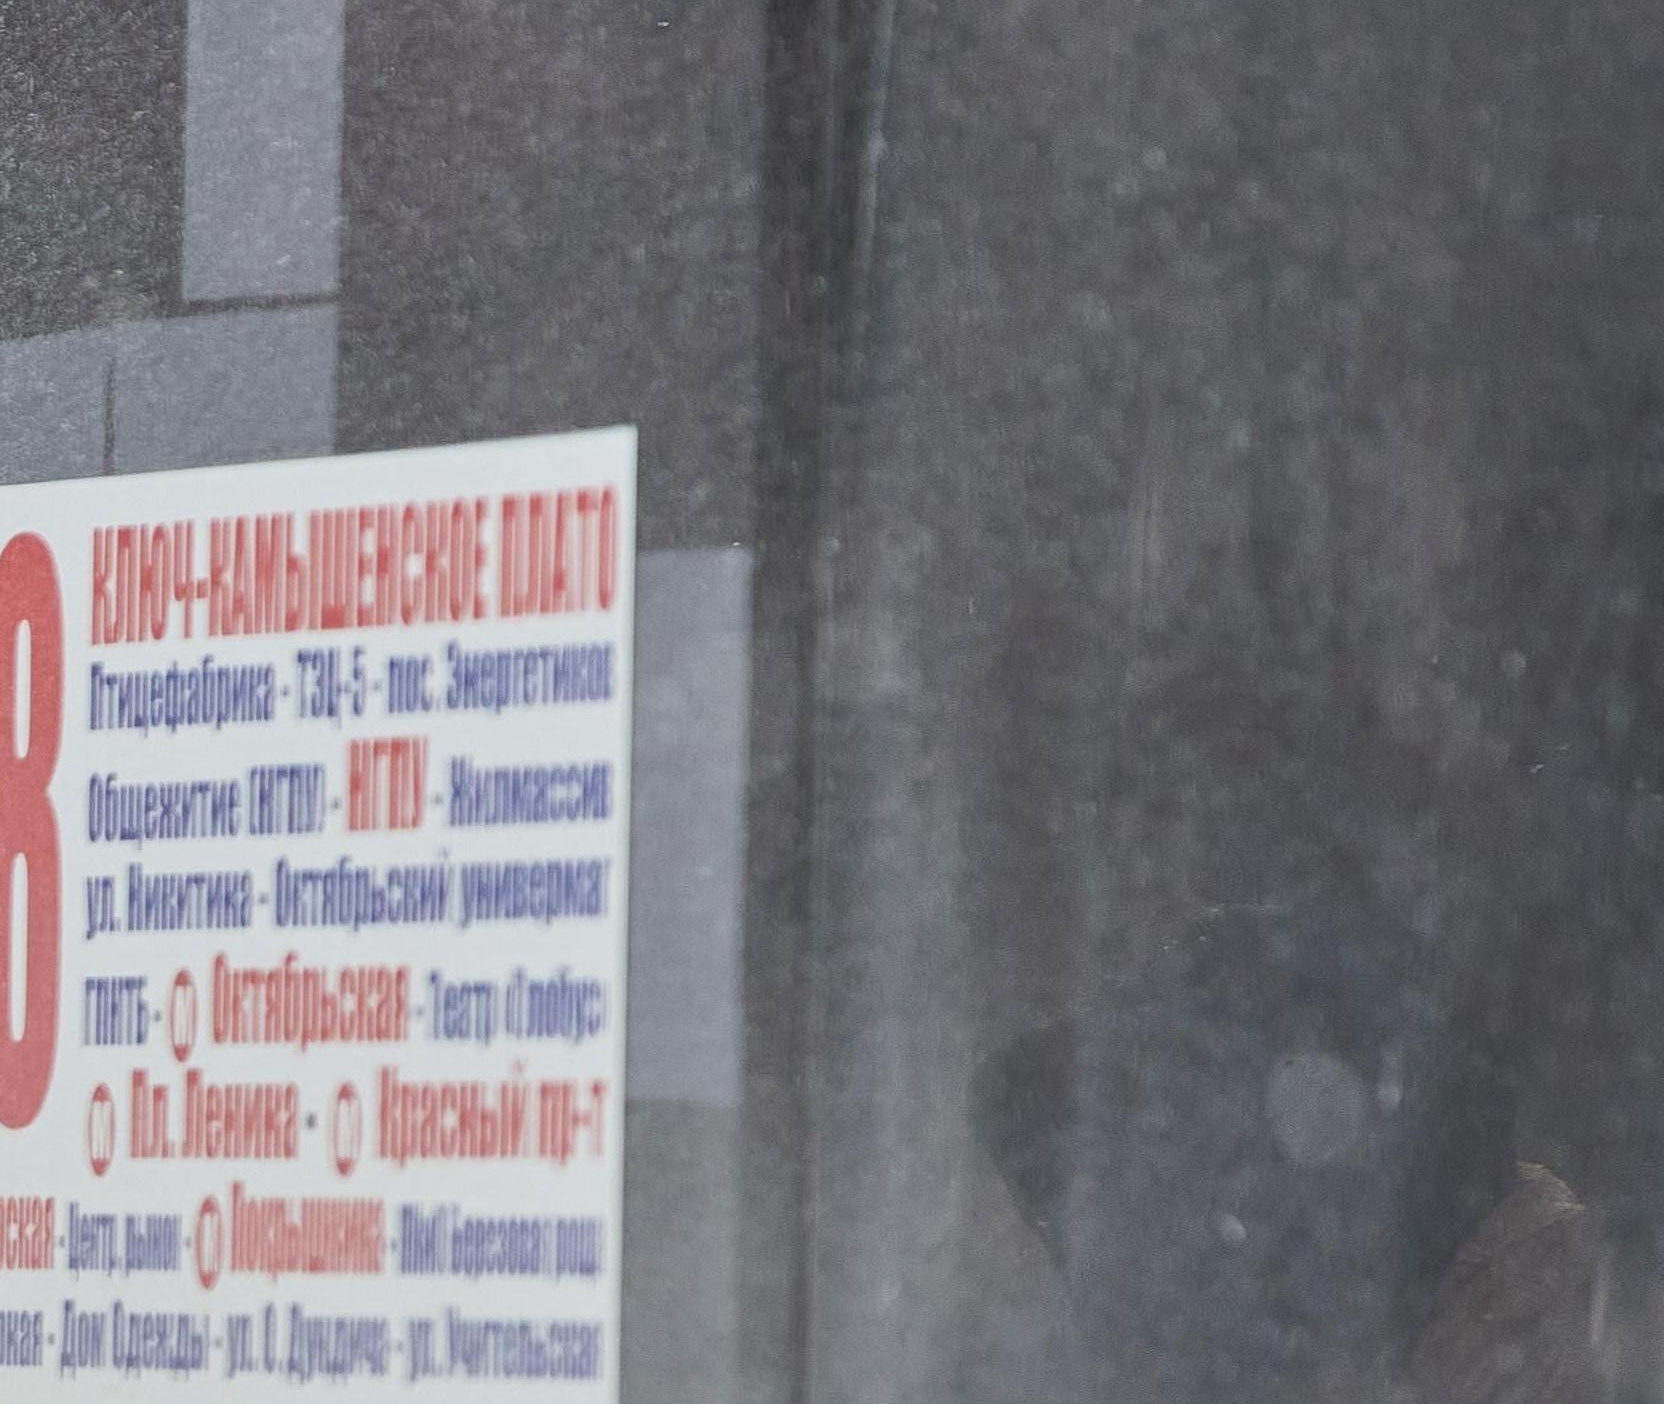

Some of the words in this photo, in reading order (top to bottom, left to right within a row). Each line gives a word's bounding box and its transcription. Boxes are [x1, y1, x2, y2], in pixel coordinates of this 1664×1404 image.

[90, 496, 488, 646] КЛЮЧ-КАМЫШЕНСКОЕ
[497, 484, 618, 620] ПЛАТО
[88, 655, 275, 738] Птицефабрика
[296, 645, 366, 728] ТЭЦ-5
[387, 655, 441, 714] пос.
[87, 772, 242, 850] Общежитие
[347, 735, 429, 832] НГПУ
[85, 874, 122, 941] ул.
[126, 862, 253, 931] Никитина
[274, 848, 451, 932] Октябрьский
[212, 952, 409, 1050] Октябрьская
[181, 1067, 300, 1159] Ленина
[376, 1058, 529, 1166] Красный
[60, 1300, 106, 1380] Дом
[111, 1300, 210, 1381] Одежды
